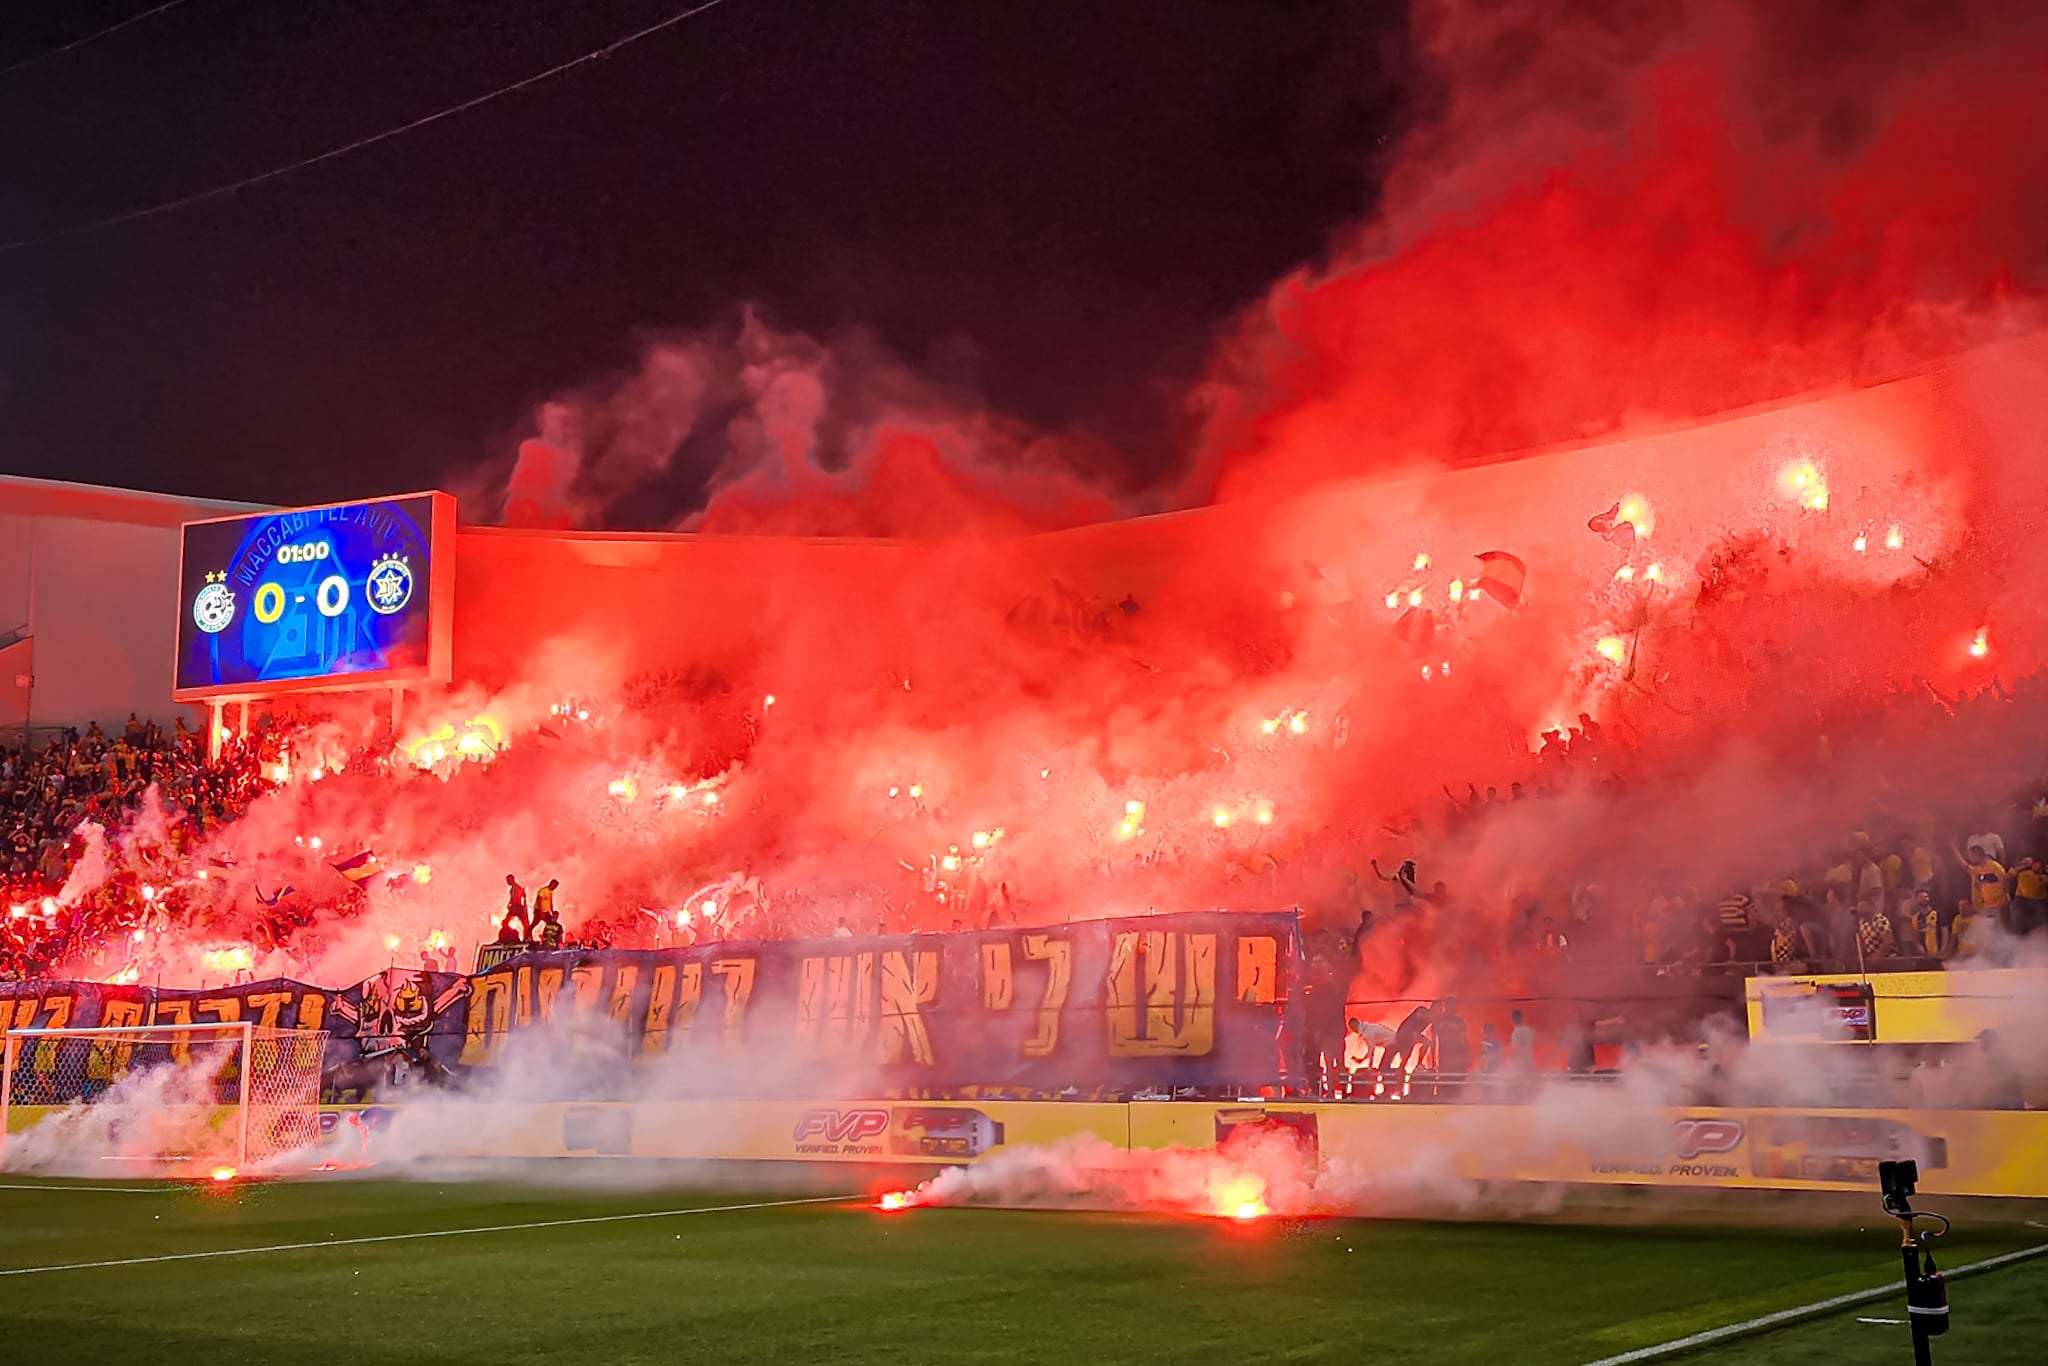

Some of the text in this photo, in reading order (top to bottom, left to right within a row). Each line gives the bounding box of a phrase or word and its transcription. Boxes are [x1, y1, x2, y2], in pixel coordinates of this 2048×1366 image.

[236, 514, 310, 587] MACCABI
[354, 504, 400, 541] AVIV
[277, 541, 330, 566] 01:00
[254, 582, 286, 624] 0
[316, 575, 350, 617] 0
[794, 1109, 889, 1141] FVP
[796, 1144, 839, 1154] VERIFIED.
[1669, 1164, 1740, 1178] PROVEN.
